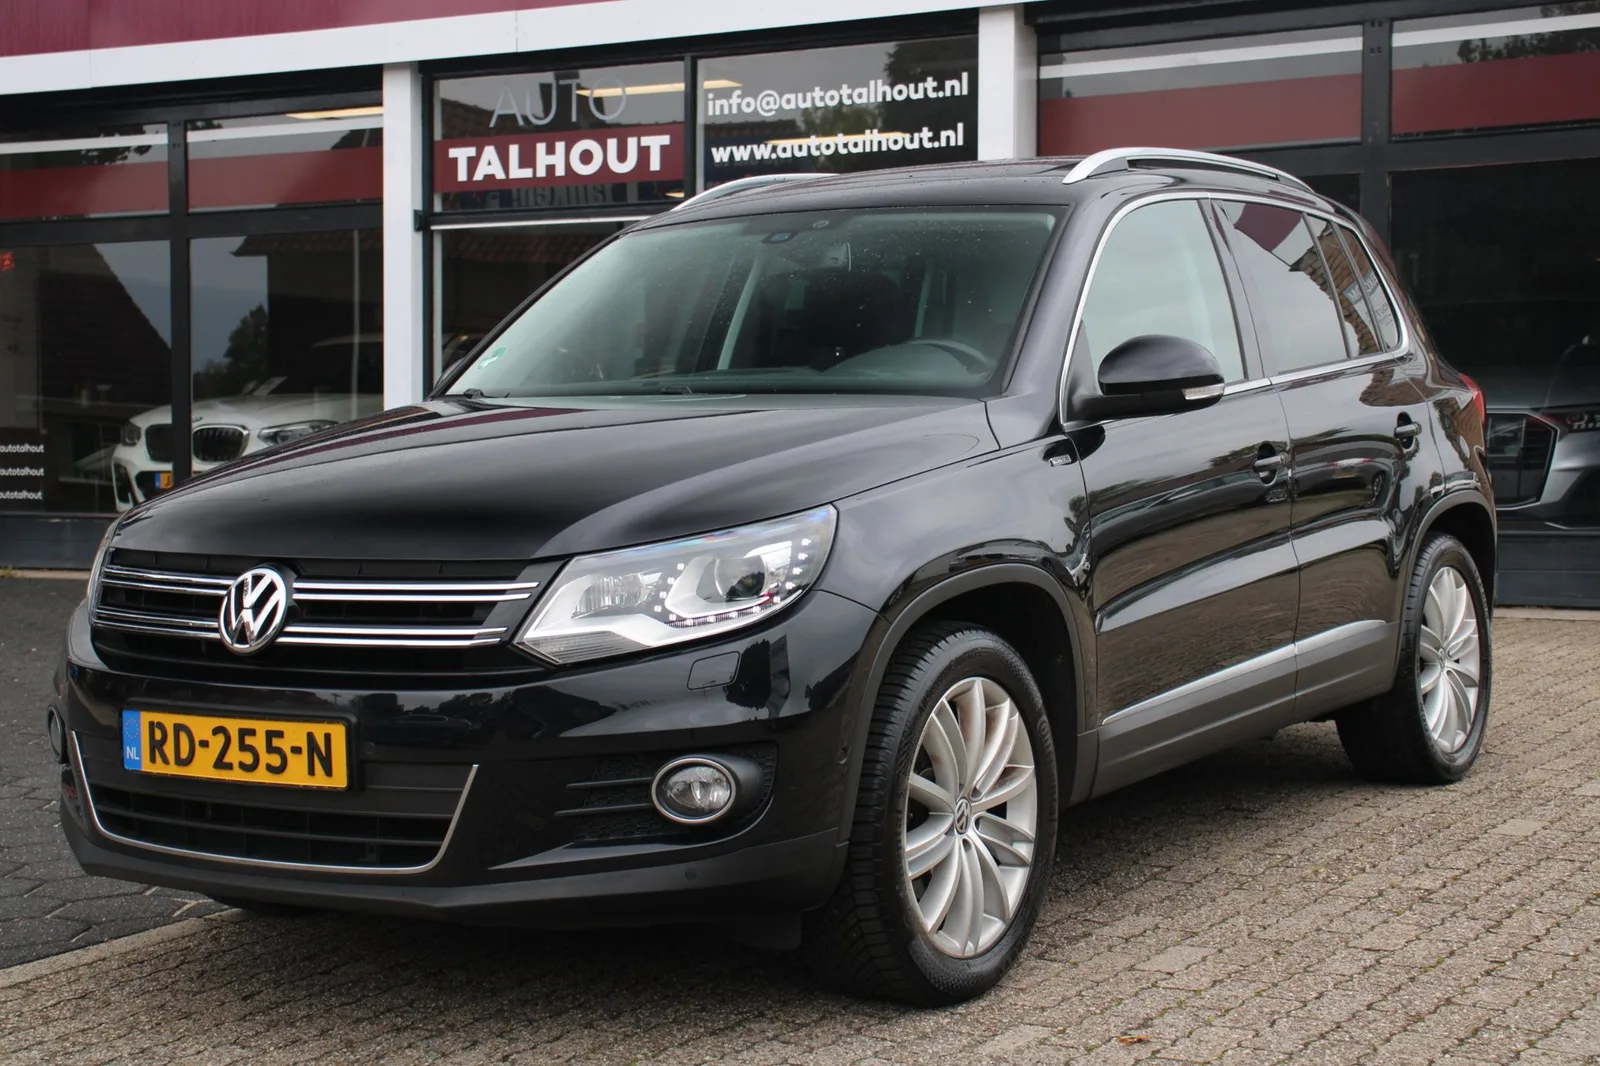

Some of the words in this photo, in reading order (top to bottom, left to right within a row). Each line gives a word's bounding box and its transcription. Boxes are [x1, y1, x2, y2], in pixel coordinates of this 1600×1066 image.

[489, 77, 626, 128] AUTO
[708, 72, 968, 117] info@autotalhout.nl
[448, 135, 671, 182] TALHOUT
[711, 123, 964, 163] www.autotalhout.nl
[126, 746, 140, 760] NL
[148, 720, 333, 777] RD-255-N
